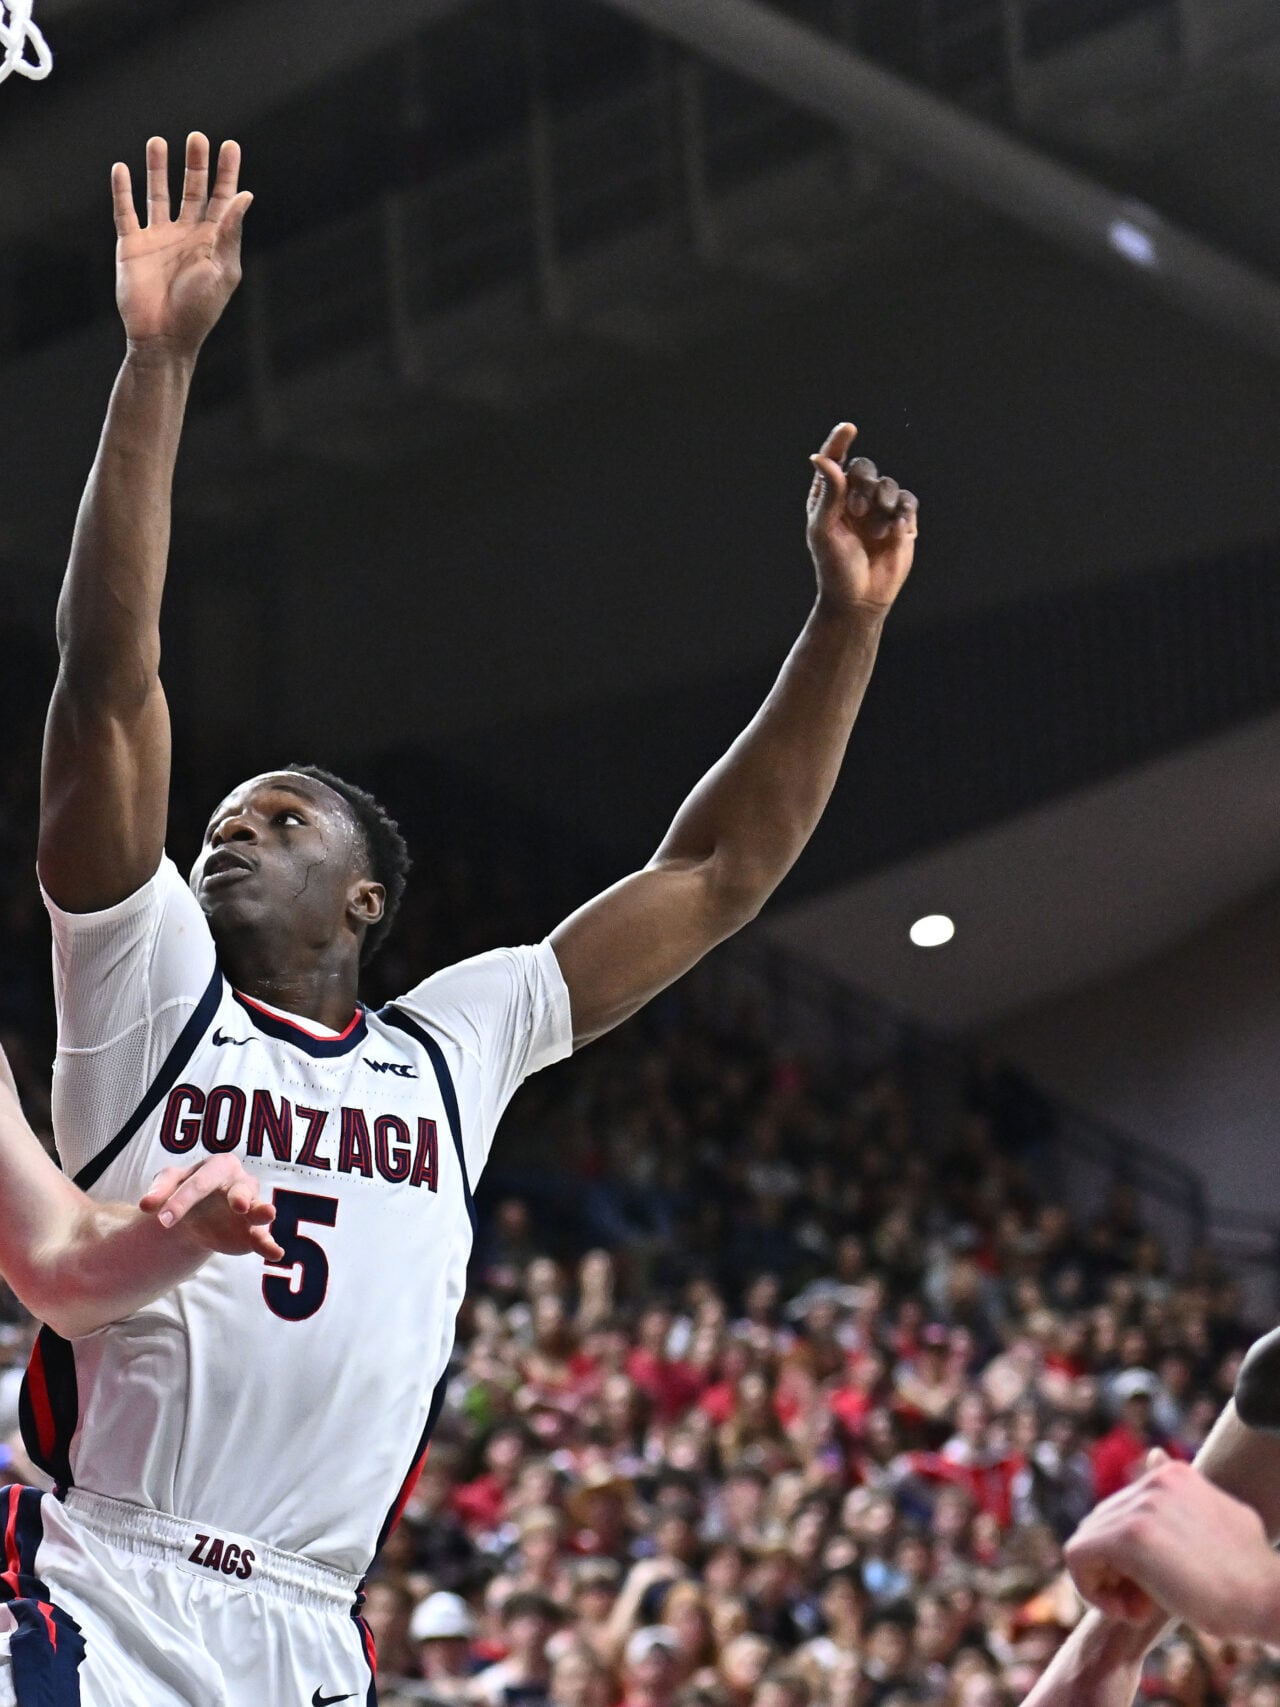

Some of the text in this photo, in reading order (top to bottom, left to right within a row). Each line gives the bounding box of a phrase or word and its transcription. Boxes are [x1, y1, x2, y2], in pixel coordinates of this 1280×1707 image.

[363, 1057, 419, 1079] WCC
[159, 1083, 439, 1194] GONZAGA
[261, 1188, 339, 1322] 5
[188, 1533, 256, 1580] ZAGS
